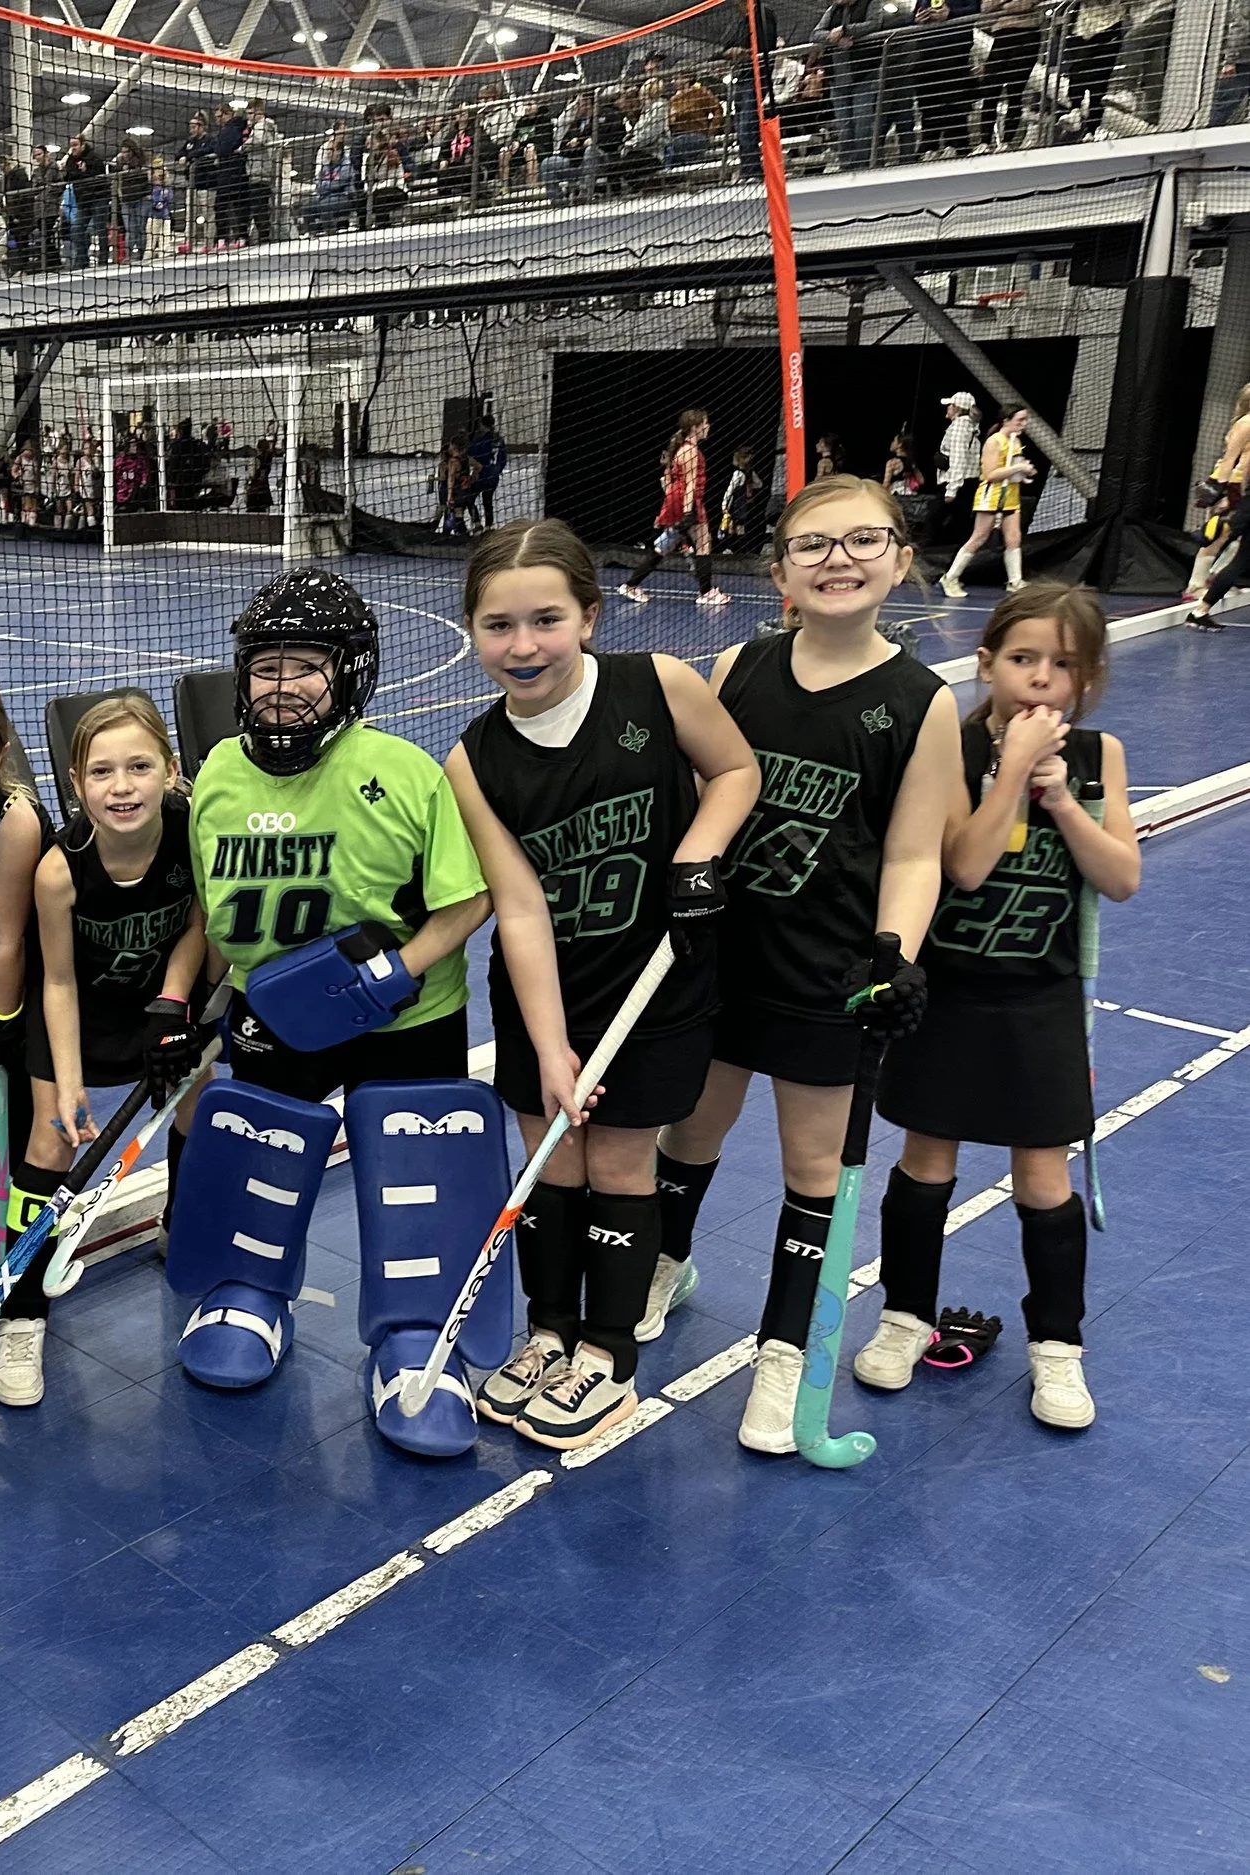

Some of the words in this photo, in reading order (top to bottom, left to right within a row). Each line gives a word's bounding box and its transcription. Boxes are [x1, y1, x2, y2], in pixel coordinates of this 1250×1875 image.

[246, 812, 297, 833] OBO
[519, 787, 655, 872] DYNASTY
[209, 831, 338, 881] DYNASTY
[76, 894, 193, 951] DYNASTY
[215, 884, 334, 947] 10
[539, 852, 648, 937] 29
[928, 880, 1075, 959] 23
[588, 1225, 635, 1247] STX
